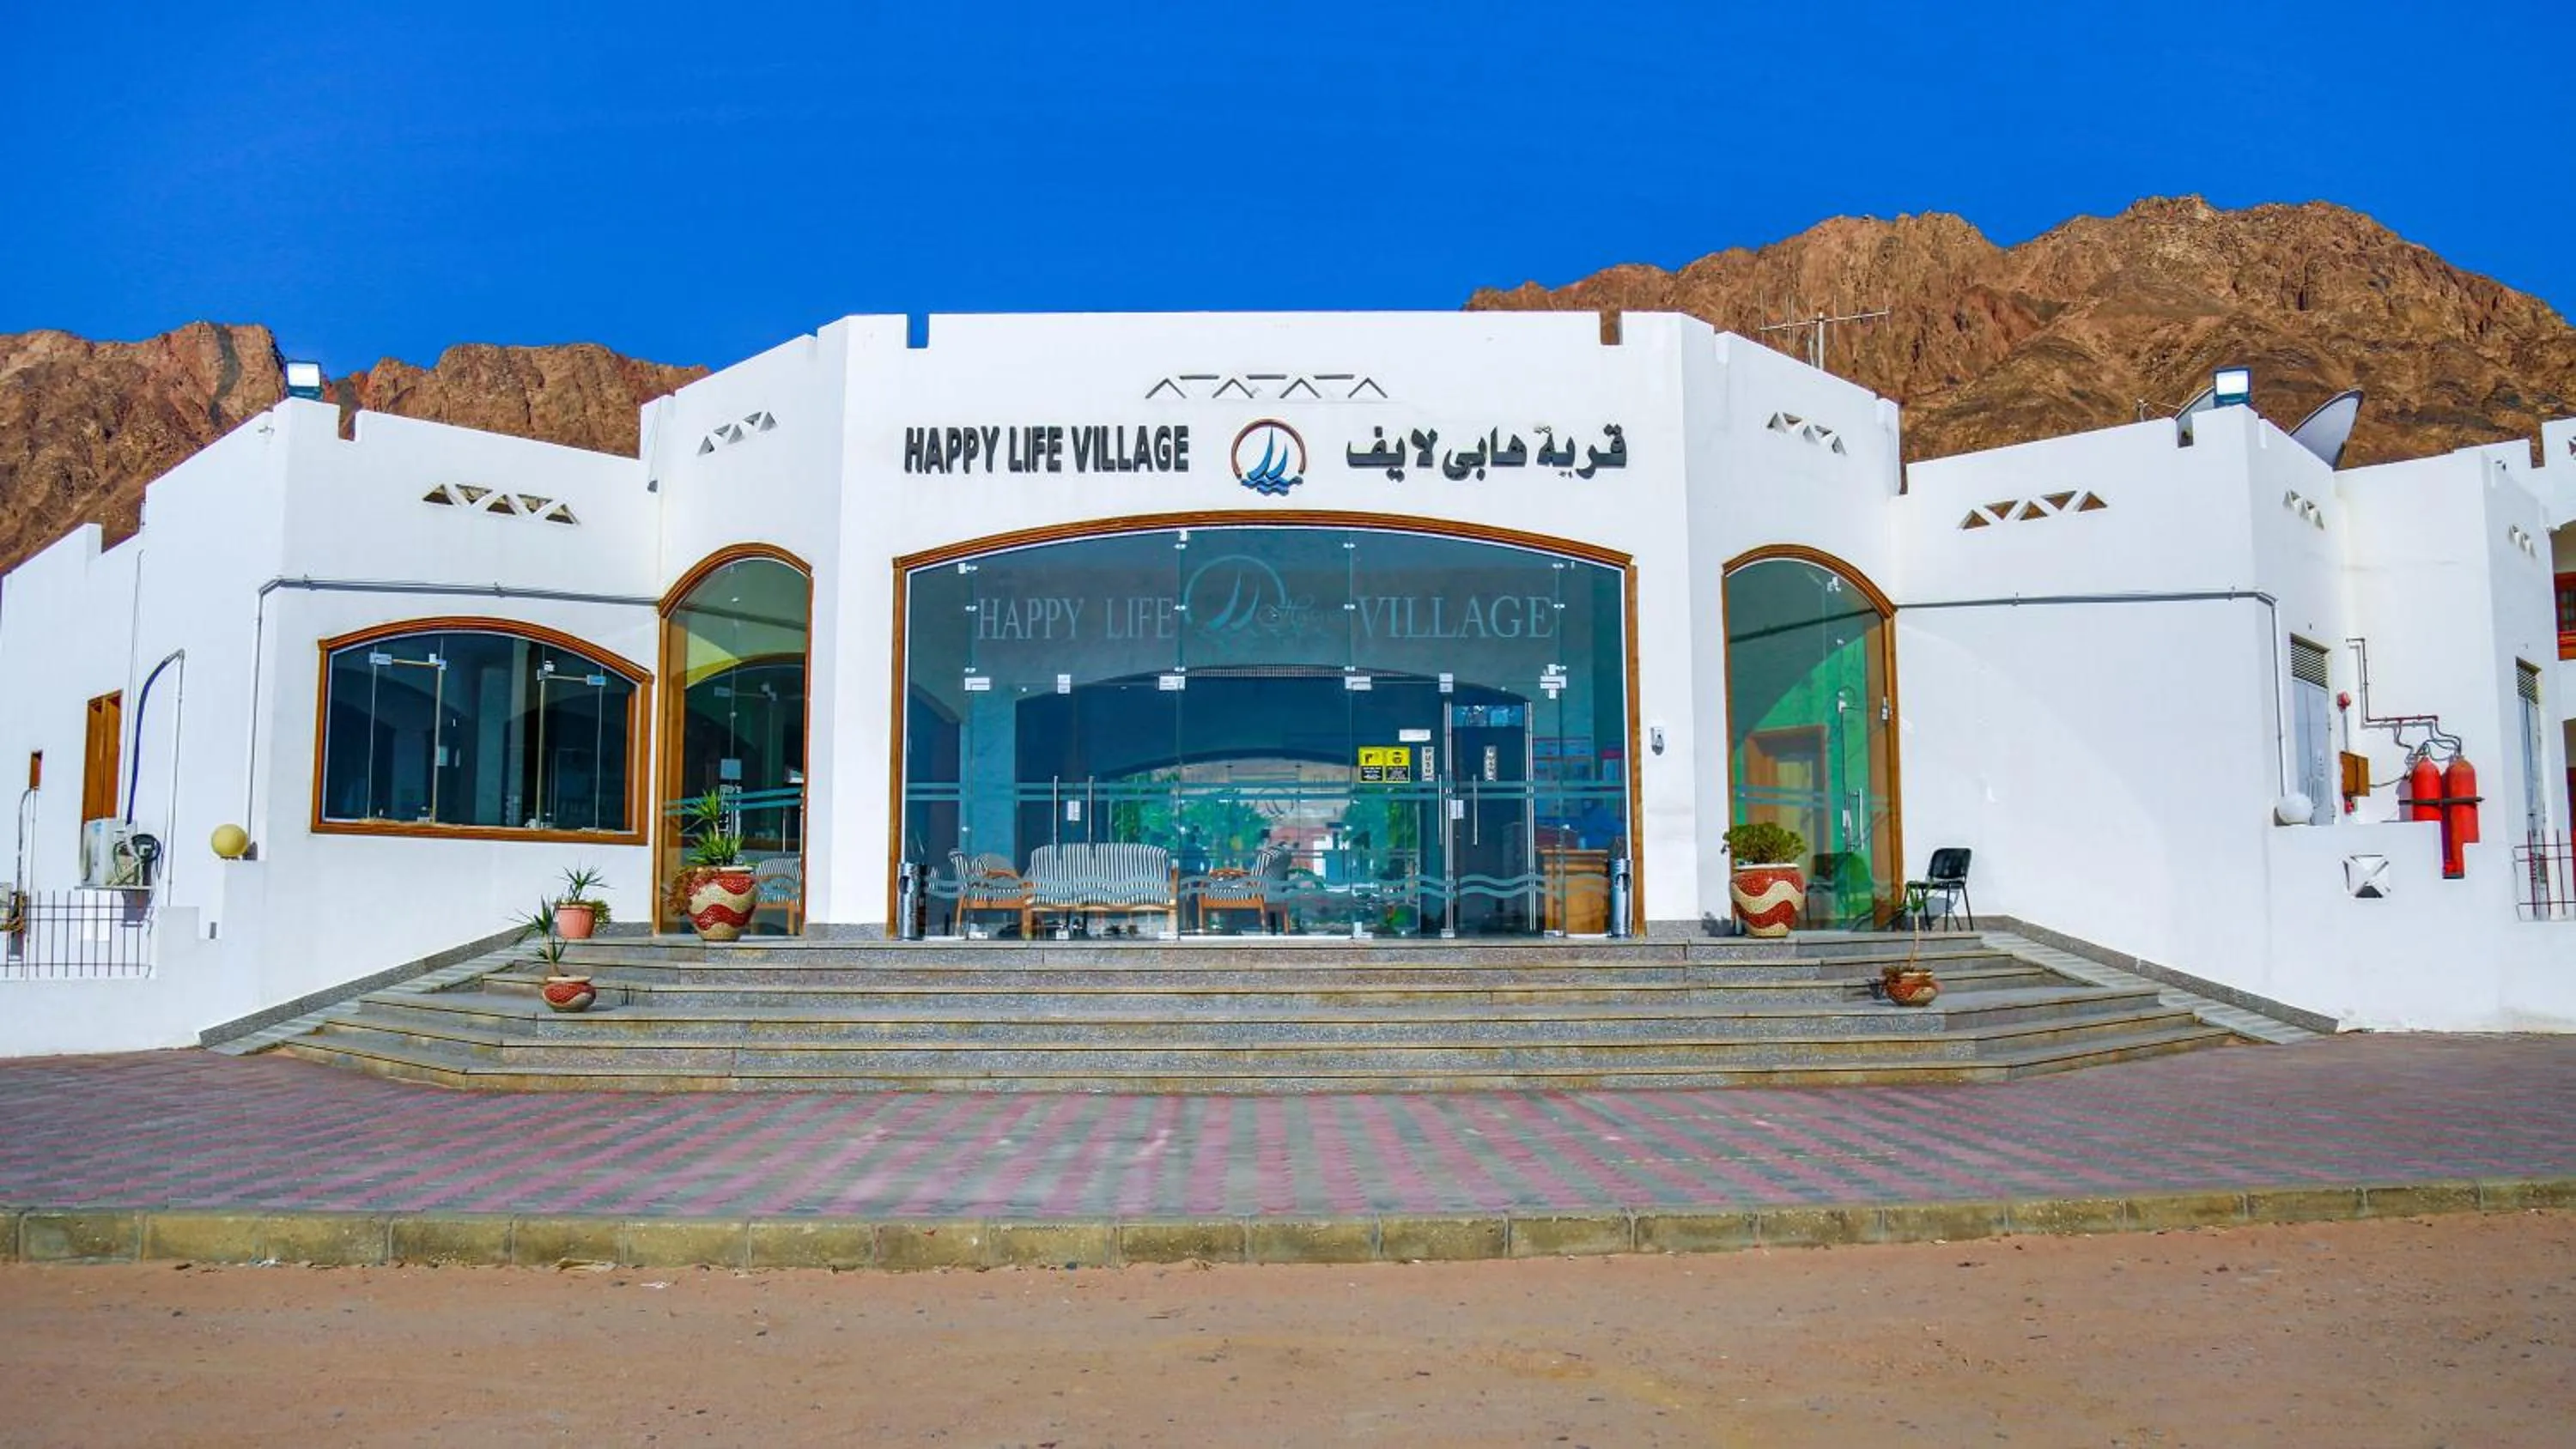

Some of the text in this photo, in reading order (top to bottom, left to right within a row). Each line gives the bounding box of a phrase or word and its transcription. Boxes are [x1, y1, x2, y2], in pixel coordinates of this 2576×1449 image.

[904, 425, 1190, 475] HAPPY LIFE VILLAGE
[1346, 426, 1438, 482] لايف
[1534, 423, 1627, 480] قرية
[977, 597, 1084, 640] HAPPY
[1105, 597, 1176, 639] LIFE
[1355, 595, 1555, 639] VILLAGE
